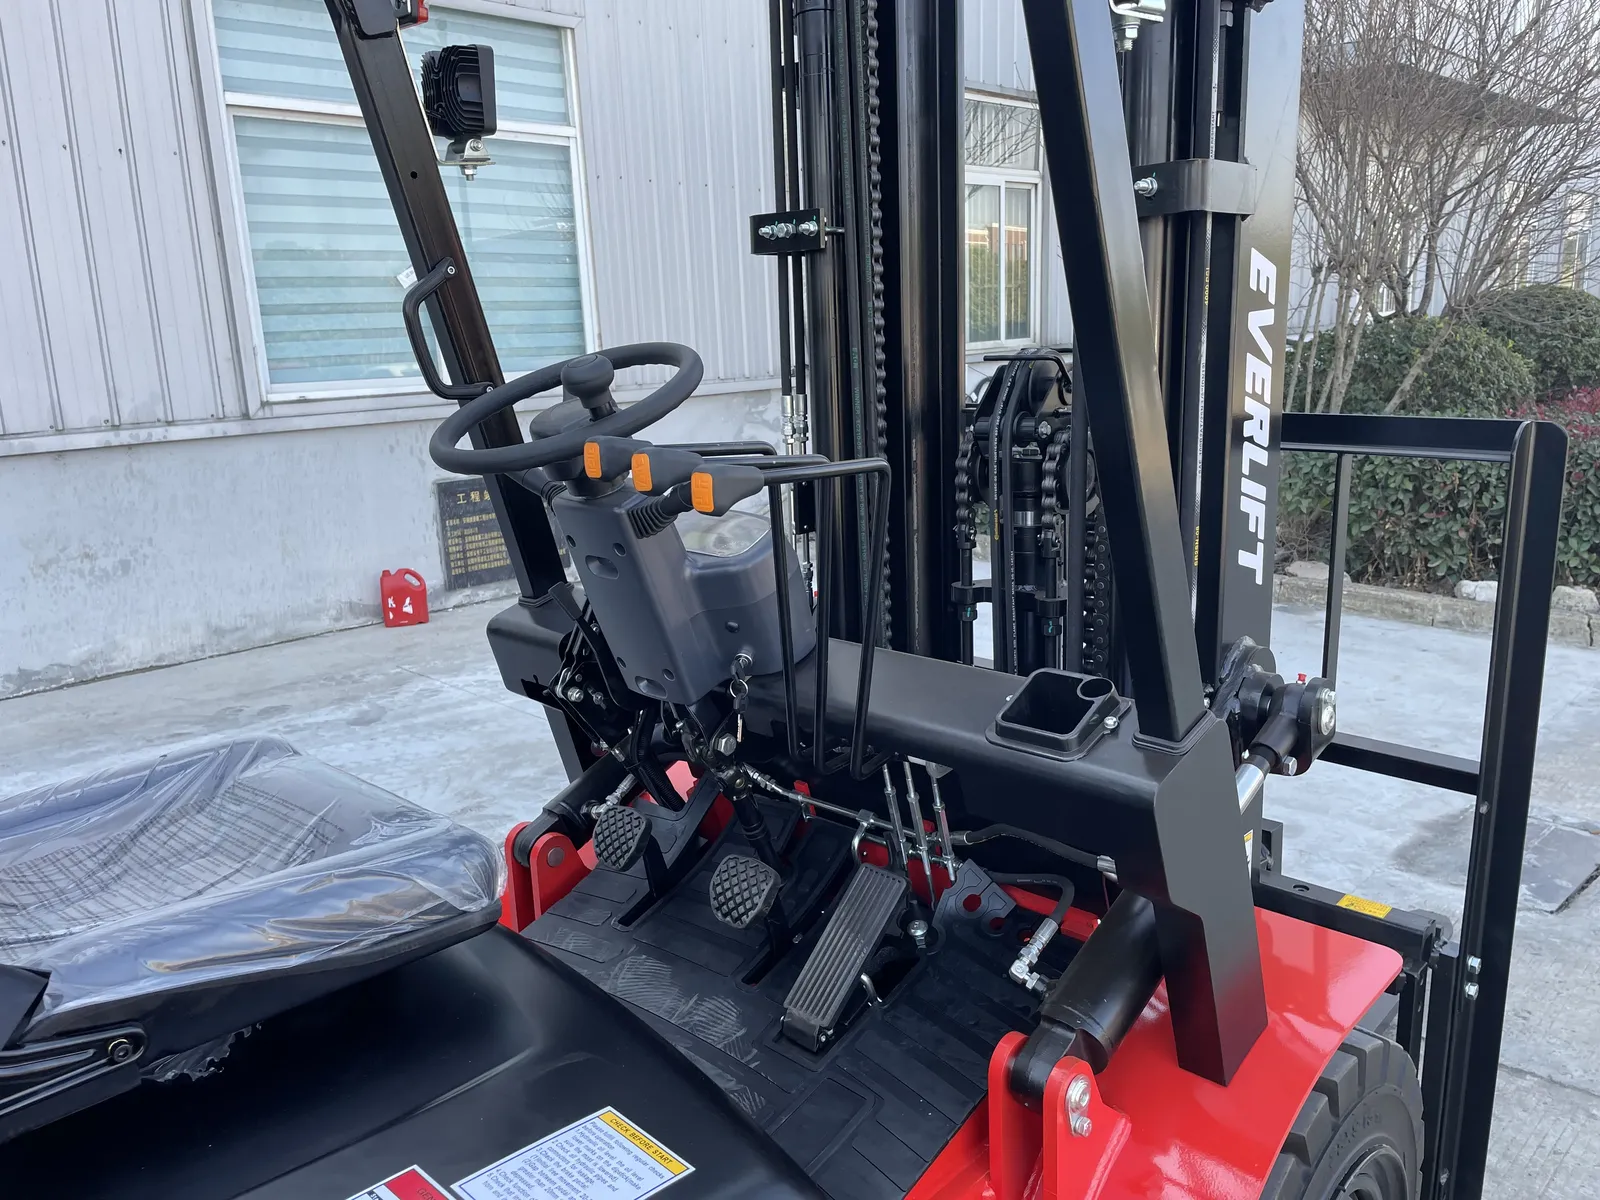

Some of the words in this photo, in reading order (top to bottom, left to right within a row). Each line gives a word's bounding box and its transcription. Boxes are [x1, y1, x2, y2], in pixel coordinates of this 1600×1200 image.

[1238, 247, 1277, 585] EVERLIFT
[610, 1118, 630, 1132] CHECK
[628, 1132, 652, 1149] BEFORE
[651, 1150, 672, 1163] START
[647, 1166, 665, 1178] checks
